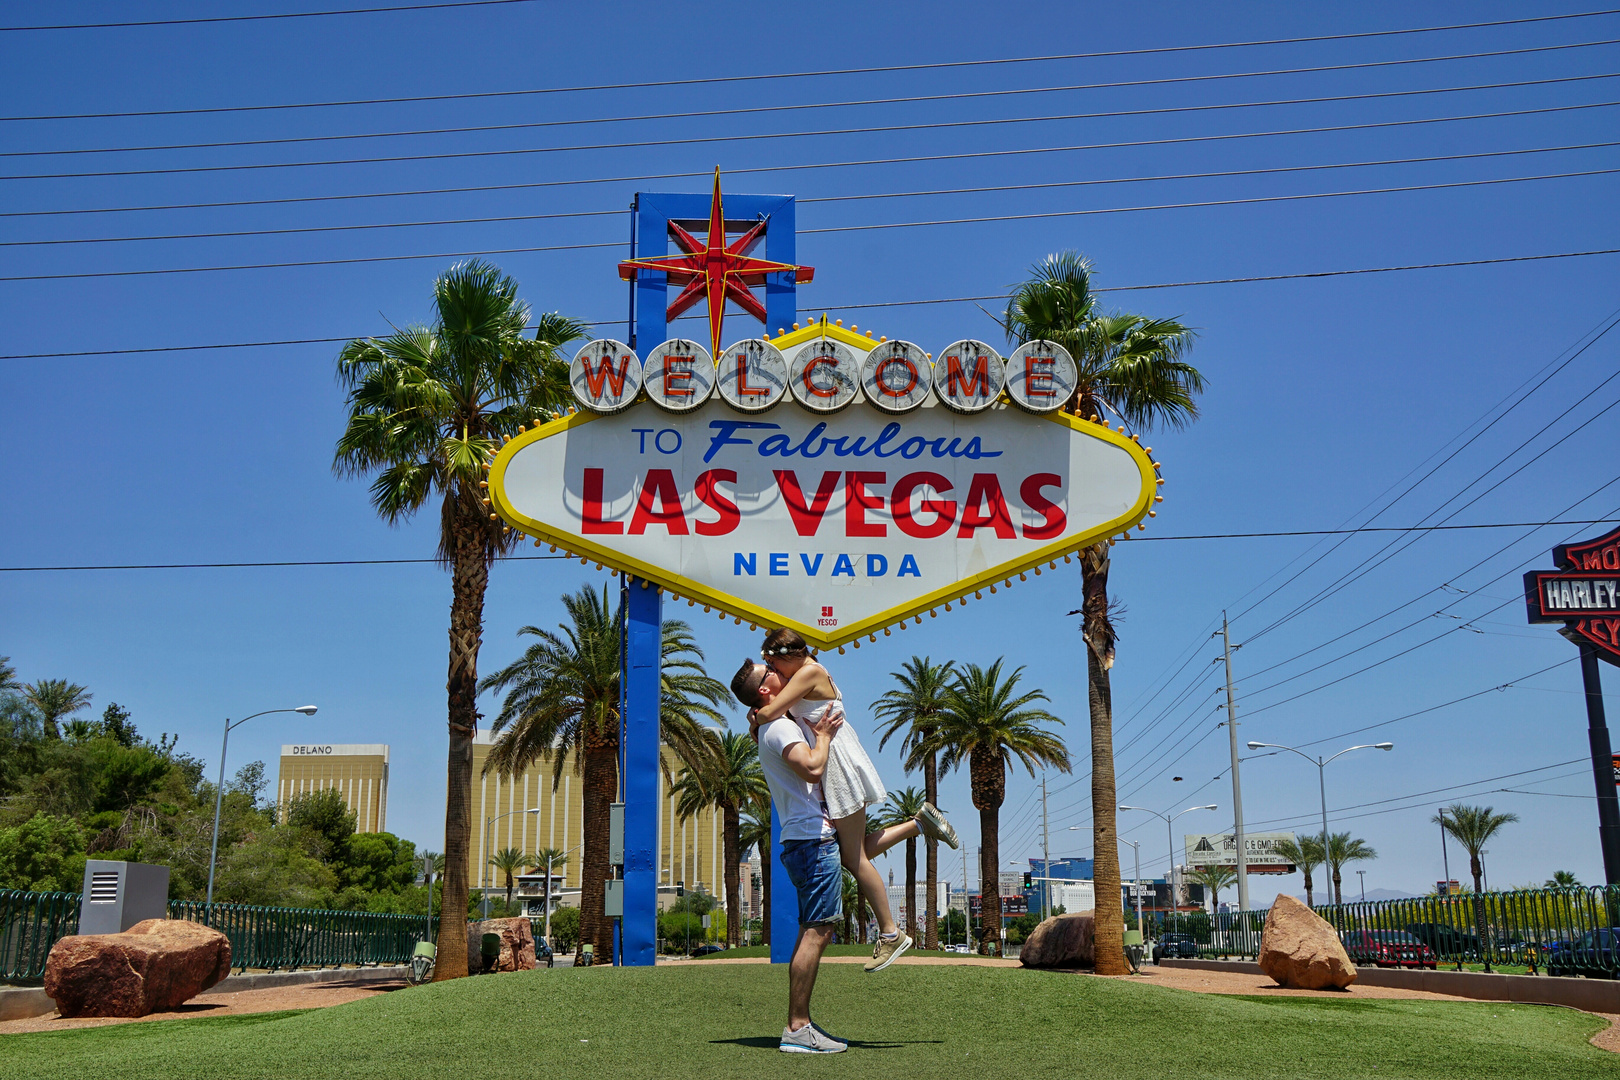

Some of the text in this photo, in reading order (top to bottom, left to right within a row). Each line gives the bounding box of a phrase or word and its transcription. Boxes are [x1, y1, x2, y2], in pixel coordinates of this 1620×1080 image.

[581, 353, 1057, 398] WELCOME
[631, 419, 1003, 464] TO Fabulous
[581, 468, 1067, 540] LAS VEGAS
[733, 552, 922, 577] NEVADA
[1582, 541, 1620, 570] MO
[817, 618, 838, 626] YESCO
[293, 746, 332, 755] DELANO
[1223, 840, 1250, 850] ORGC
